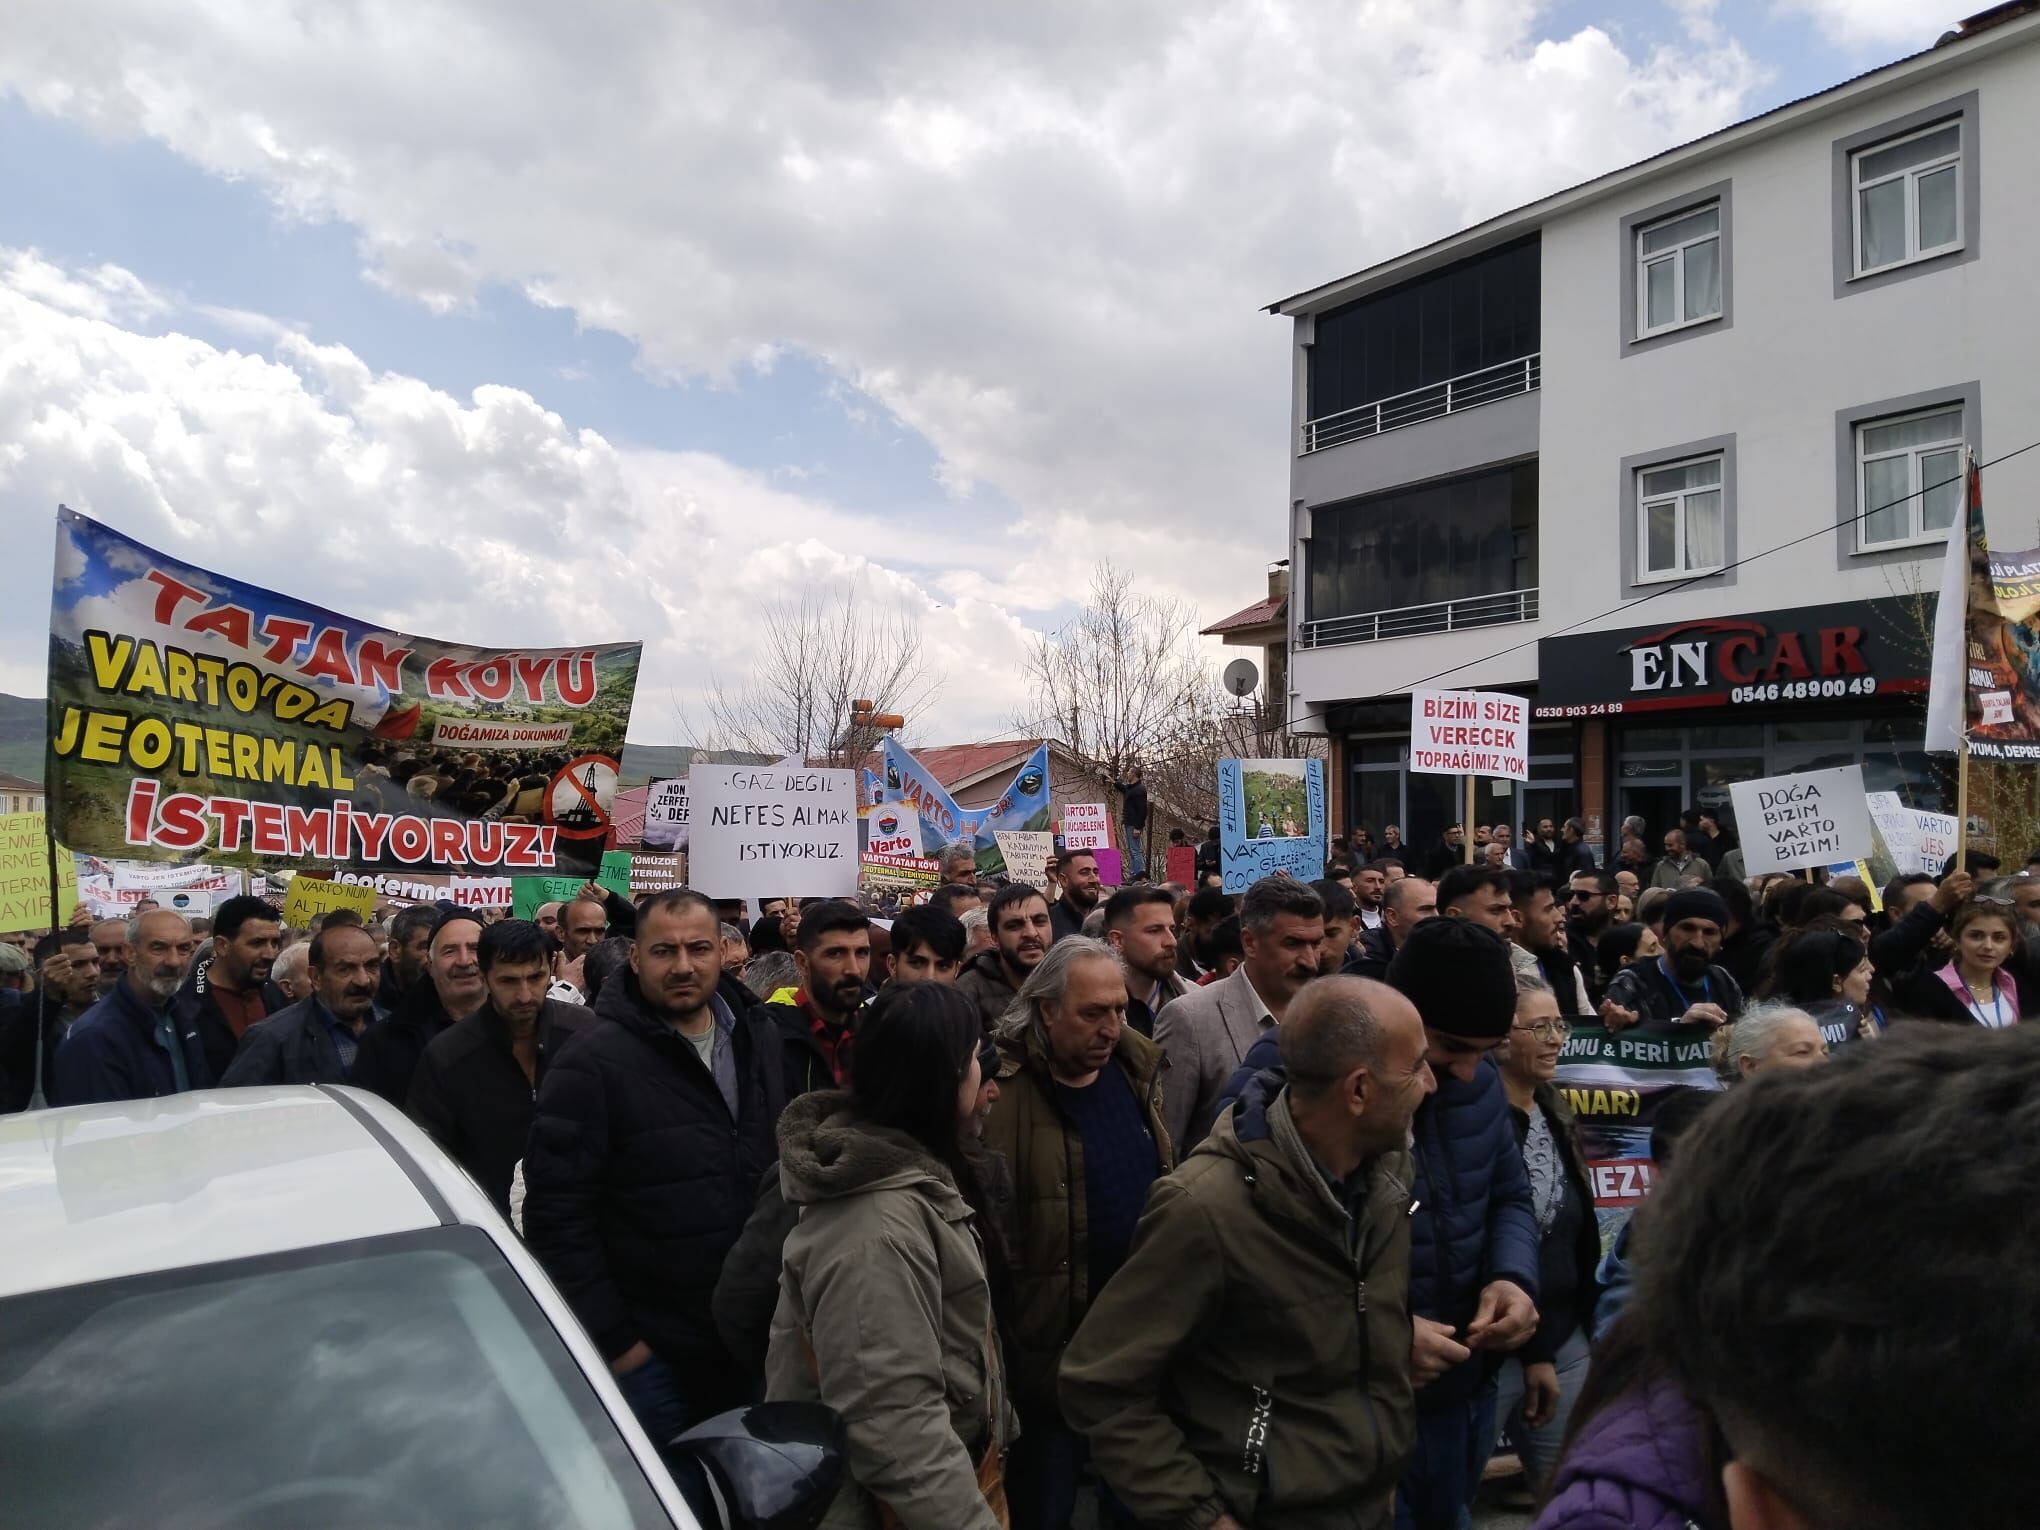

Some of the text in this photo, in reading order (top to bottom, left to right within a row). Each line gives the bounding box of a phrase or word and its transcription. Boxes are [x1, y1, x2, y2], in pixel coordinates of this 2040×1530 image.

[143, 567, 597, 707] TATAN KÖYÜ
[86, 630, 352, 734] VARTO'DA
[1731, 684, 1779, 703] 0546
[1849, 677, 1876, 695] 49
[1424, 696, 1520, 724] BİZİM SİZE
[1535, 703, 1623, 717] 0530 903 24 89
[437, 723, 568, 742] DOĞAMIZA DOKUNMA!
[1430, 726, 1515, 749] VERECEK
[53, 706, 354, 792] JEOTERMAL
[1503, 756, 1524, 775] YOK
[667, 785, 686, 795] NON
[732, 772, 775, 790] GAZ
[903, 771, 955, 832] VARTO
[1758, 784, 1821, 810] DOĞA
[125, 777, 557, 867] İSTEMİYORUZ!
[711, 804, 850, 827] NEFES ALMAK
[1764, 804, 1818, 826] BİZİM
[1914, 815, 1952, 835] VARTO
[1081, 837, 1097, 846] VER
[1768, 819, 1835, 843] VARTO
[870, 837, 912, 853] Varto
[1223, 841, 1276, 861] VARTO
[1775, 834, 1840, 860] BİZİM!
[1921, 837, 1944, 856] JES
[863, 853, 889, 863] VARTO
[891, 857, 916, 868] TATAN
[918, 860, 939, 871] KÖYÜ
[84, 884, 112, 902] JES
[300, 880, 343, 896] VARTO
[1603, 1043, 1615, 1057] &
[1620, 1040, 1669, 1063] PERİ
